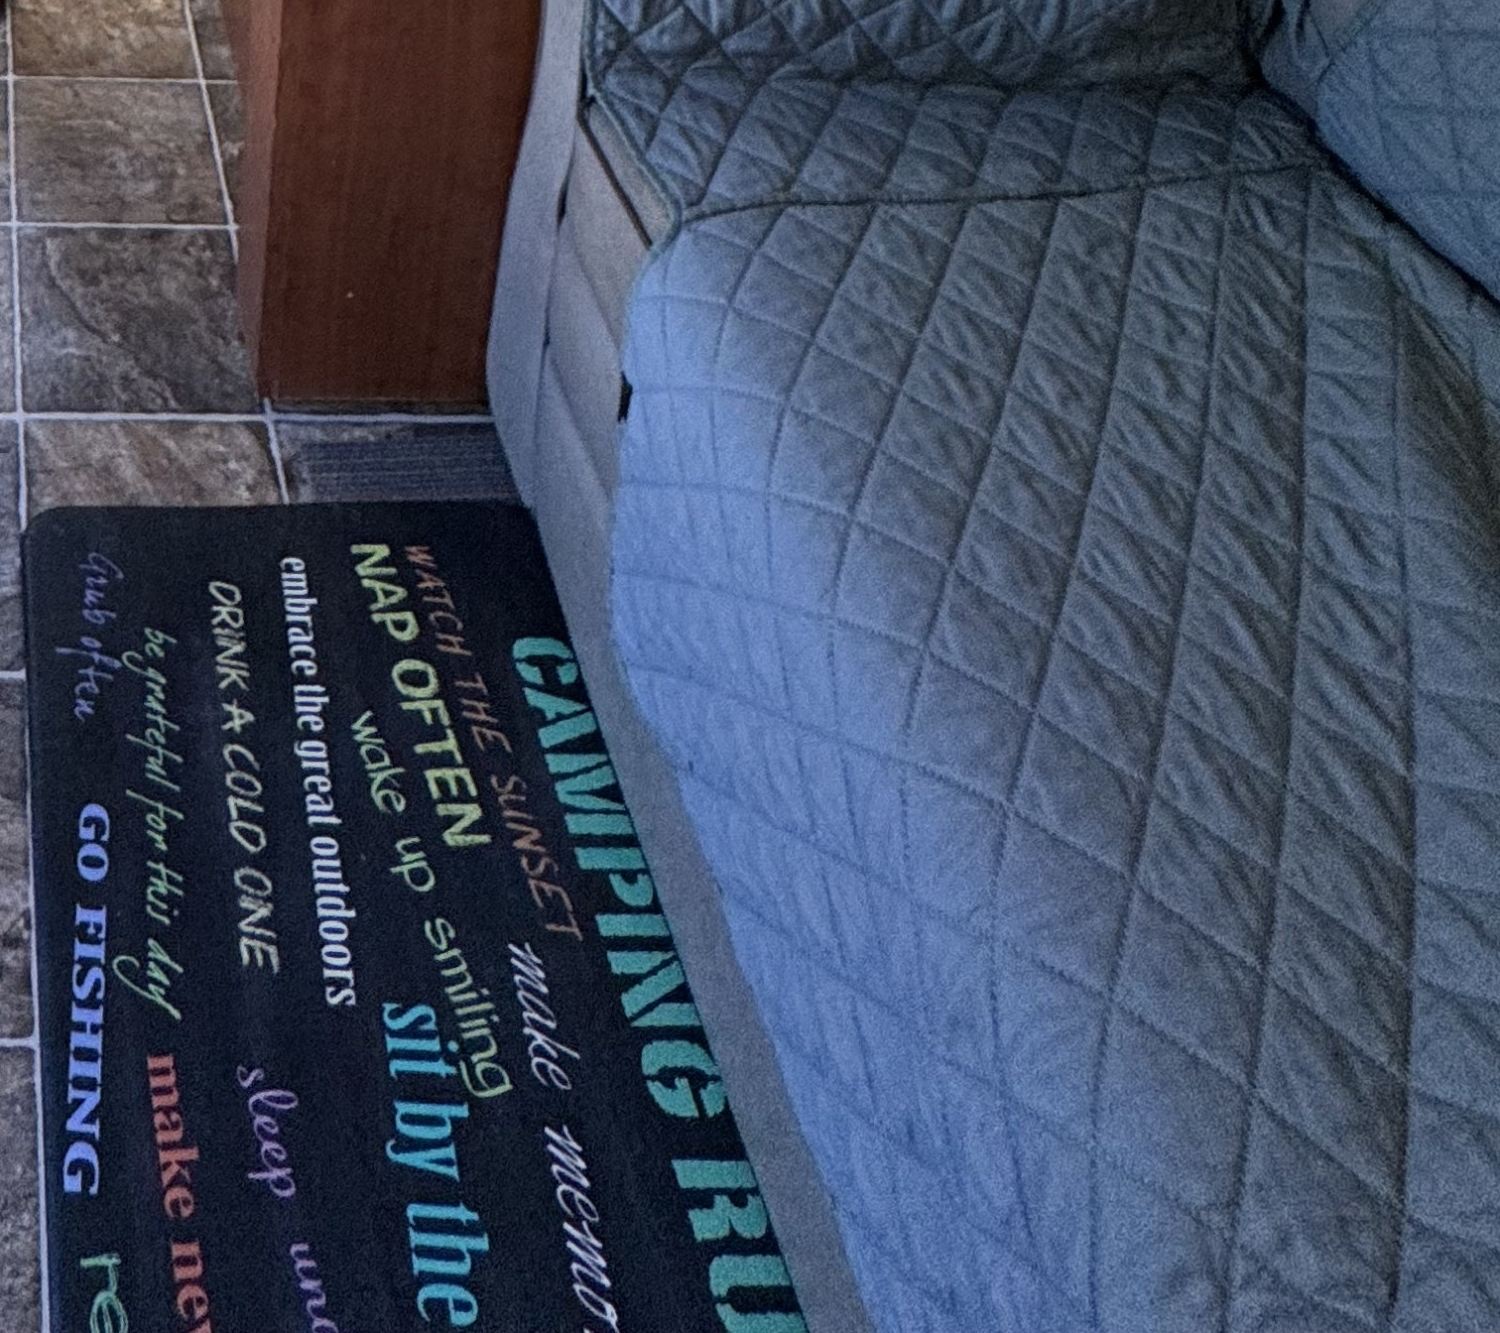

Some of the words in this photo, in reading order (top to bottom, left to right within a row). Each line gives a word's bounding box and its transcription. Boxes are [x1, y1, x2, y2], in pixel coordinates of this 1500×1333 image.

[78, 551, 125, 624] Grub
[208, 580, 250, 691] DRINK
[279, 556, 319, 676] embrace
[54, 635, 123, 723] often
[144, 627, 178, 658] be
[350, 543, 420, 642] NAP
[391, 658, 492, 847] OFTEN
[121, 650, 184, 792] grateful
[220, 698, 255, 734] A
[293, 684, 330, 733] the
[404, 545, 472, 656] WATCH
[455, 672, 513, 754] THE
[490, 773, 583, 941] SUNSET
[125, 788, 185, 852] for
[222, 743, 267, 853] COLD
[293, 740, 342, 828] great
[76, 802, 111, 882] GO
[146, 860, 184, 926] this
[233, 866, 280, 975] ONE
[309, 835, 357, 1006] outdoors
[351, 710, 406, 814] wake
[389, 836, 436, 893] up
[424, 917, 514, 1097] smiling
[112, 937, 184, 1021] day
[512, 637, 727, 1119] CAMPING
[671, 1158, 810, 1333] RU
[63, 902, 108, 1196] FISHING
[382, 1001, 460, 1080] sit
[146, 1052, 200, 1221] make
[236, 1063, 299, 1198] sleep
[385, 1099, 470, 1182] by
[507, 942, 581, 1092] make
[544, 1124, 620, 1333] memo
[79, 1252, 129, 1333] re
[170, 1237, 213, 1333] ne
[406, 1201, 490, 1327] the
